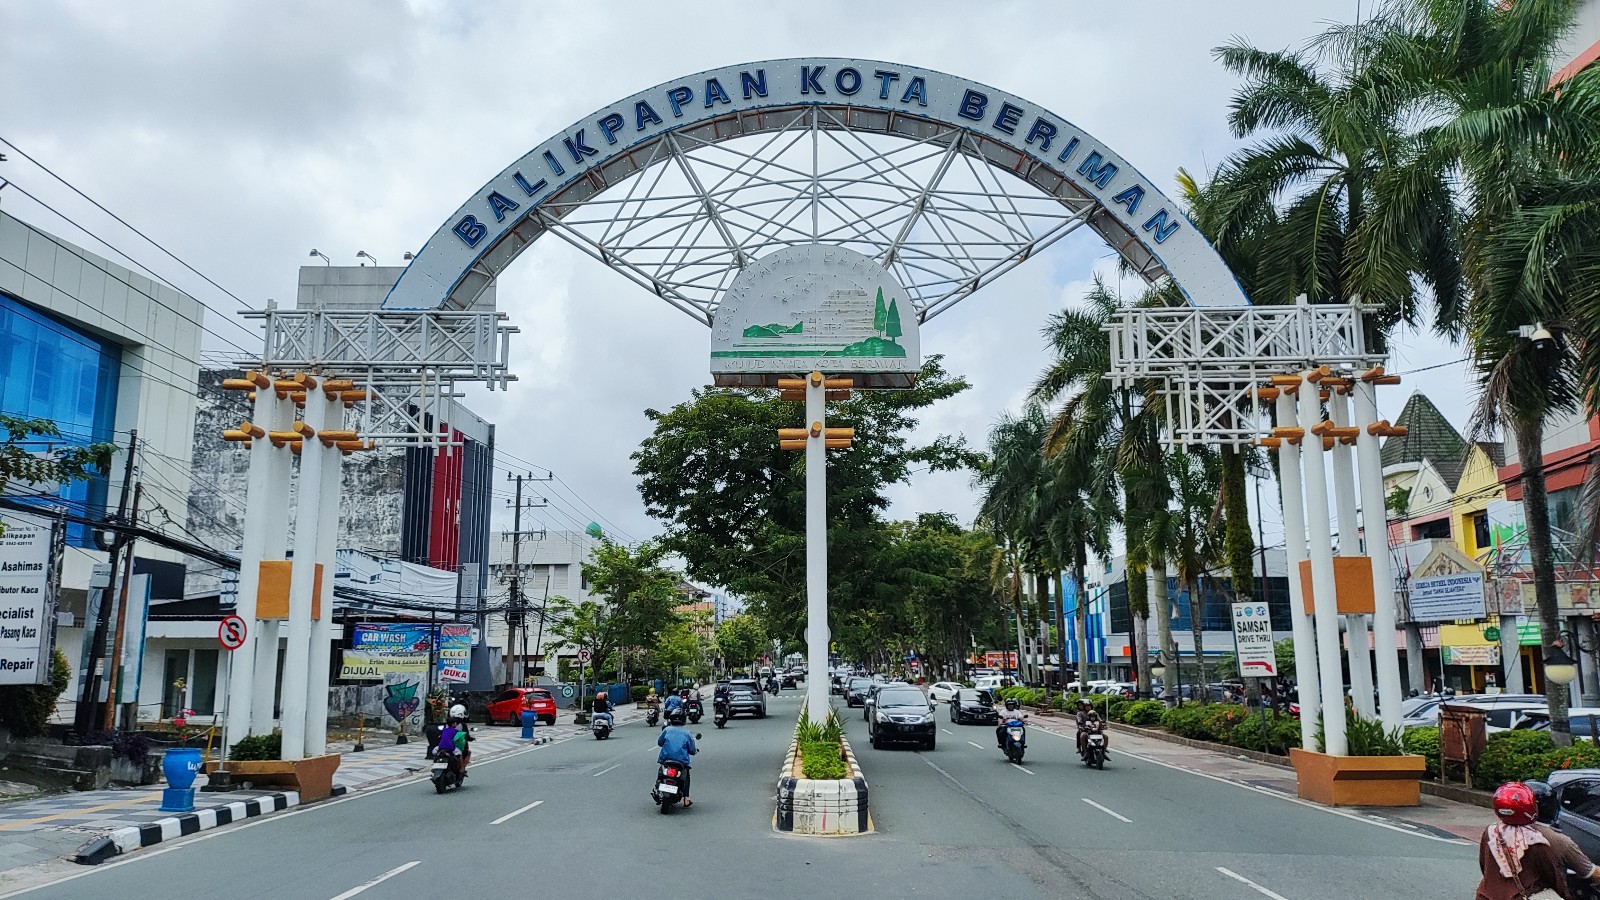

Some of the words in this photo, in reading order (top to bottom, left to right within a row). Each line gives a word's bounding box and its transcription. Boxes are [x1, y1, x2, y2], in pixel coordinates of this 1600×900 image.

[452, 68, 768, 249] BALIKPAPAN
[800, 64, 928, 107] KOTA
[958, 88, 1181, 244] BERIMAN
[1, 561, 43, 572] Asahimas
[21, 586, 39, 594] Kaca
[21, 625, 37, 638] Kaca
[226, 622, 239, 642] S
[1236, 620, 1269, 633] SAMSAT
[361, 632, 379, 643] CAR
[380, 632, 406, 643] WASH
[1238, 635, 1255, 643] DRIVE
[1256, 634, 1271, 643] THRU
[443, 650, 468, 658] CUCI
[0, 658, 34, 673] Repair
[343, 666, 381, 676] DIJUAL
[443, 668, 467, 679] BUKA
